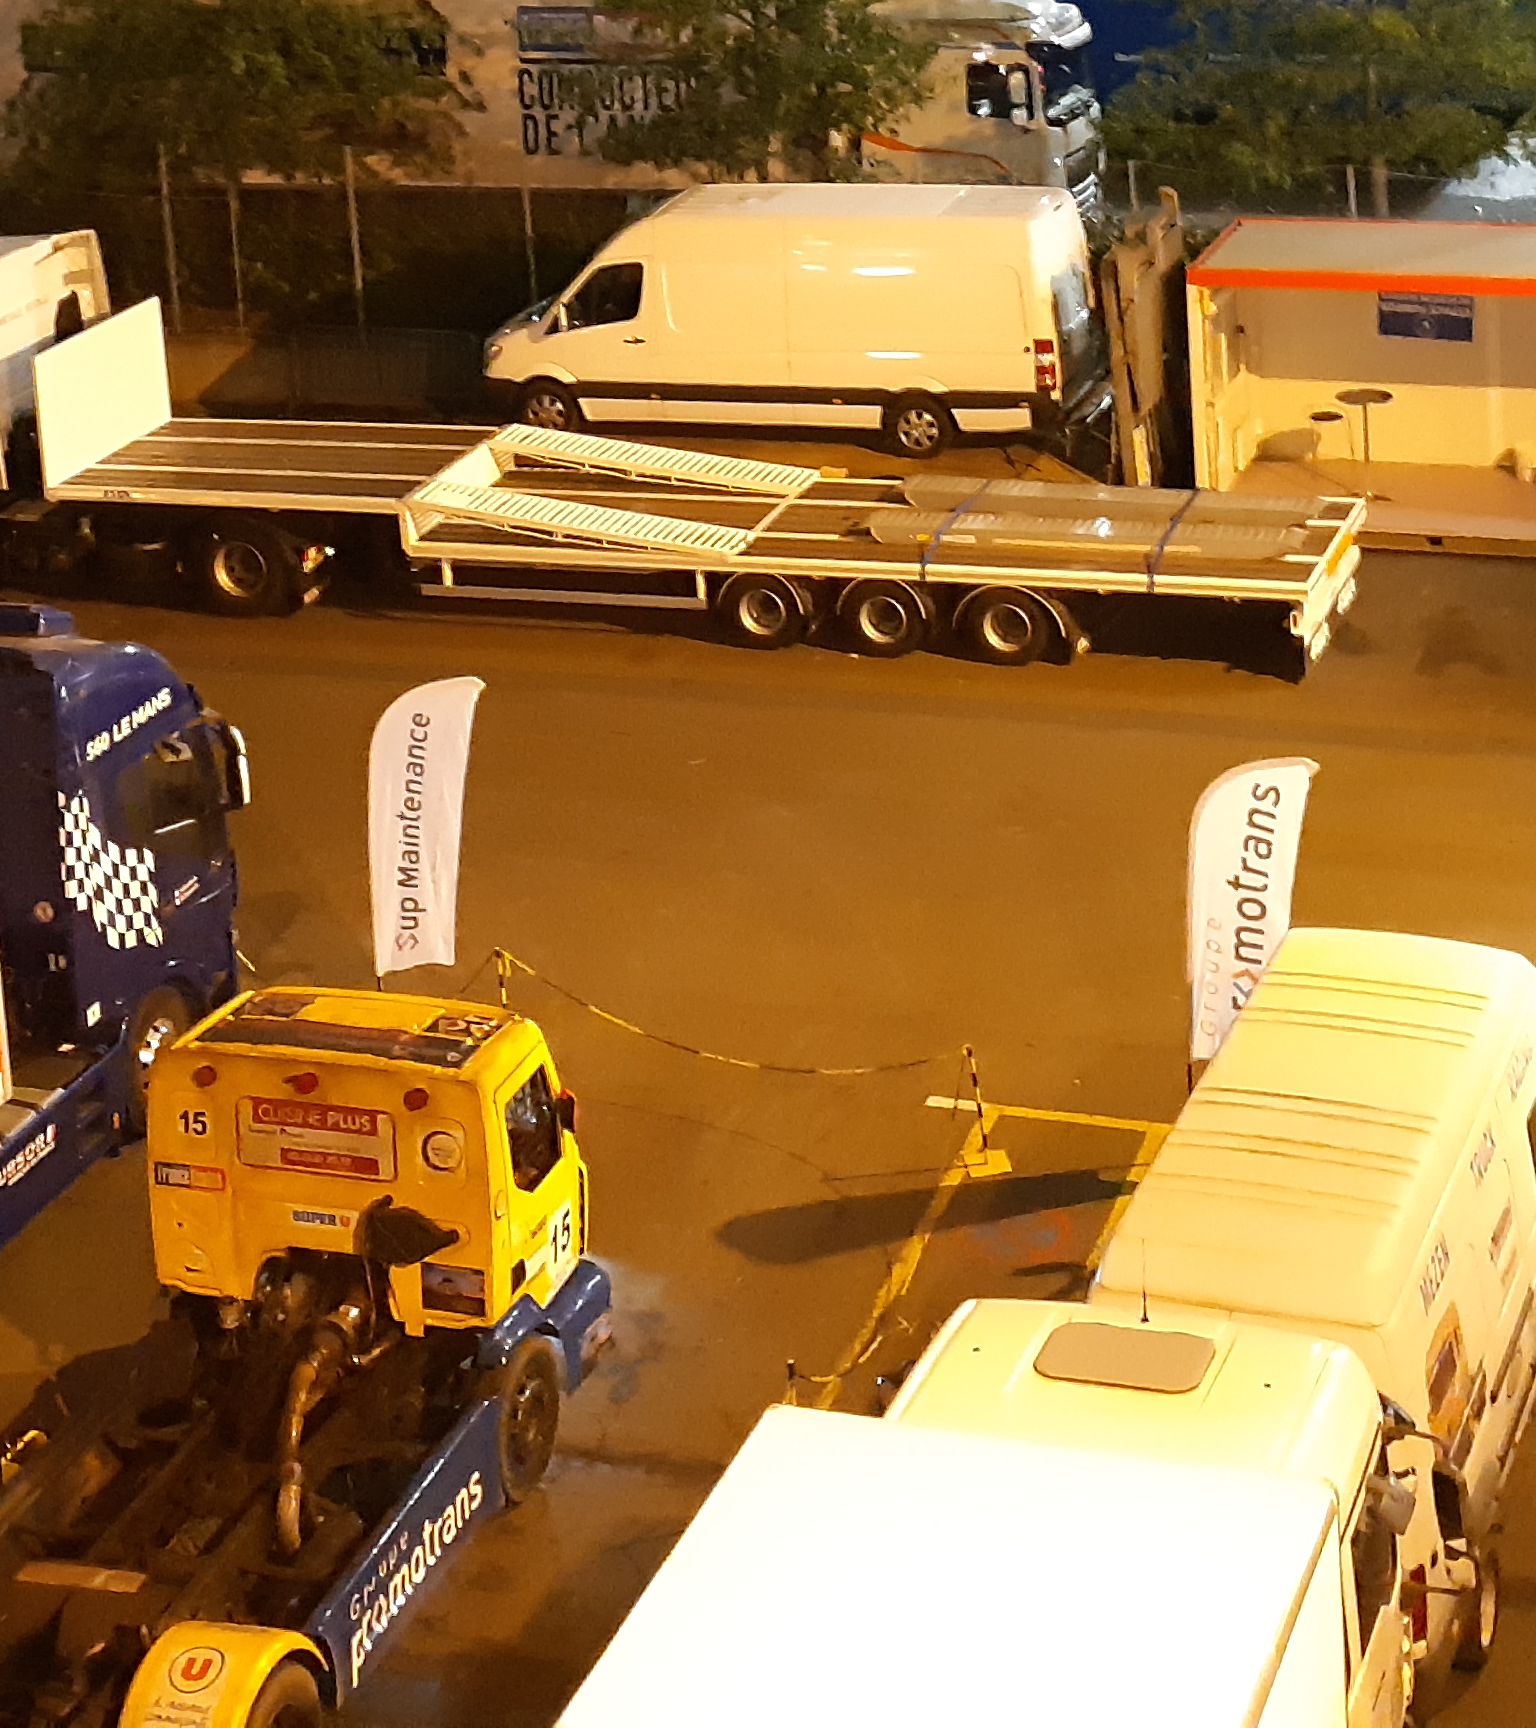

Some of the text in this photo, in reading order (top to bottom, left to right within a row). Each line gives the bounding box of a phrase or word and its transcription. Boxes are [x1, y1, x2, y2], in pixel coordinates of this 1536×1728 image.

[112, 715, 133, 743] LE
[130, 686, 173, 729] MANS
[394, 711, 431, 953] Sup Maintenance
[179, 1109, 208, 1136] 15
[325, 1110, 372, 1132] PLUS
[550, 1207, 571, 1265] 15
[349, 1469, 484, 1689] promotrans
[181, 1657, 214, 1682] U
